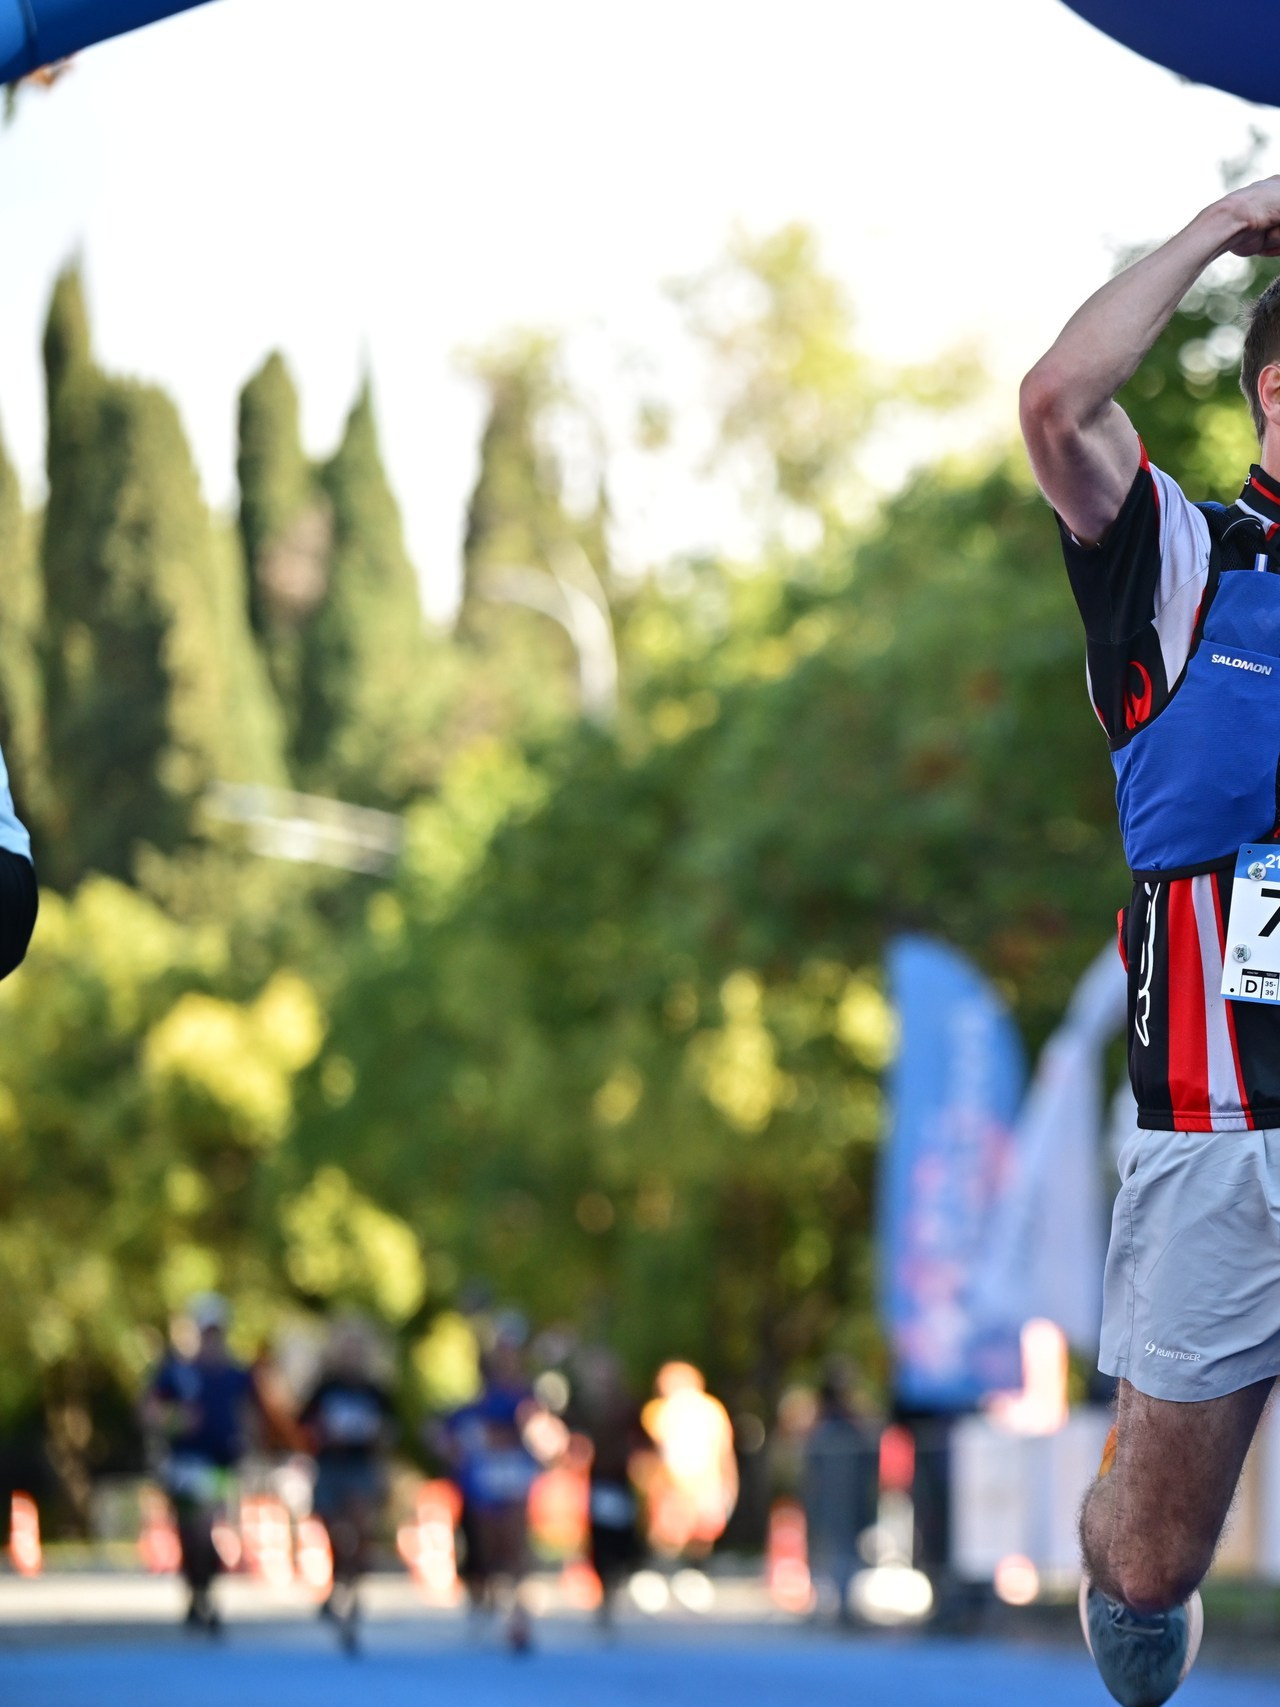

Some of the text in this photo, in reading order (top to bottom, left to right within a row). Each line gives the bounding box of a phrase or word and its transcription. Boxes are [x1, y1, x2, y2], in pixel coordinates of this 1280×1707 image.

[1211, 654, 1272, 676] SALOMON
[1245, 979, 1258, 993] D
[1156, 1348, 1201, 1362] RUNTIGER
